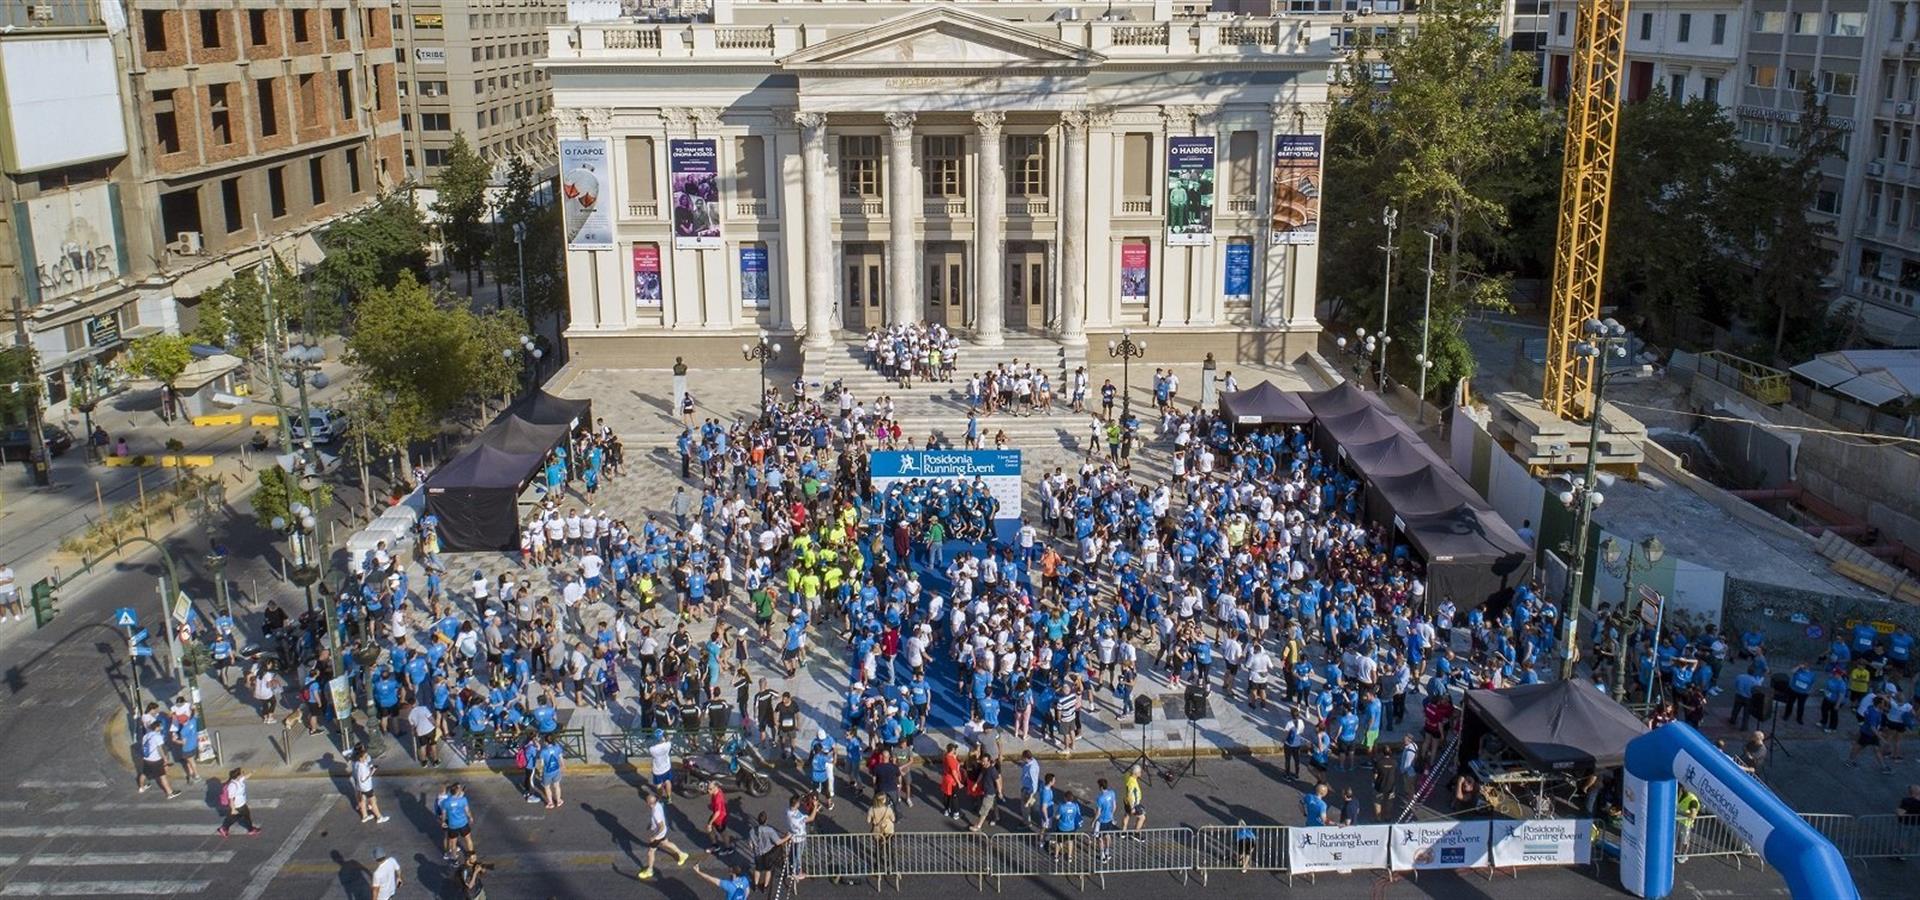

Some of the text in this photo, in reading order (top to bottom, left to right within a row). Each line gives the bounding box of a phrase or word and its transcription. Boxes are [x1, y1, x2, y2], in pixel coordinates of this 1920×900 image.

[924, 454, 973, 464] Posidonia
[924, 464, 995, 474] Running Event
[1701, 778, 1739, 816] Posidonia
[1422, 828, 1462, 837] Posidonia
[1523, 825, 1565, 833] Posidonia
[1320, 832, 1361, 841] Posidonia
[1422, 835, 1480, 845] Running Event
[1523, 832, 1582, 842] Running Event
[1320, 840, 1355, 848] Running
